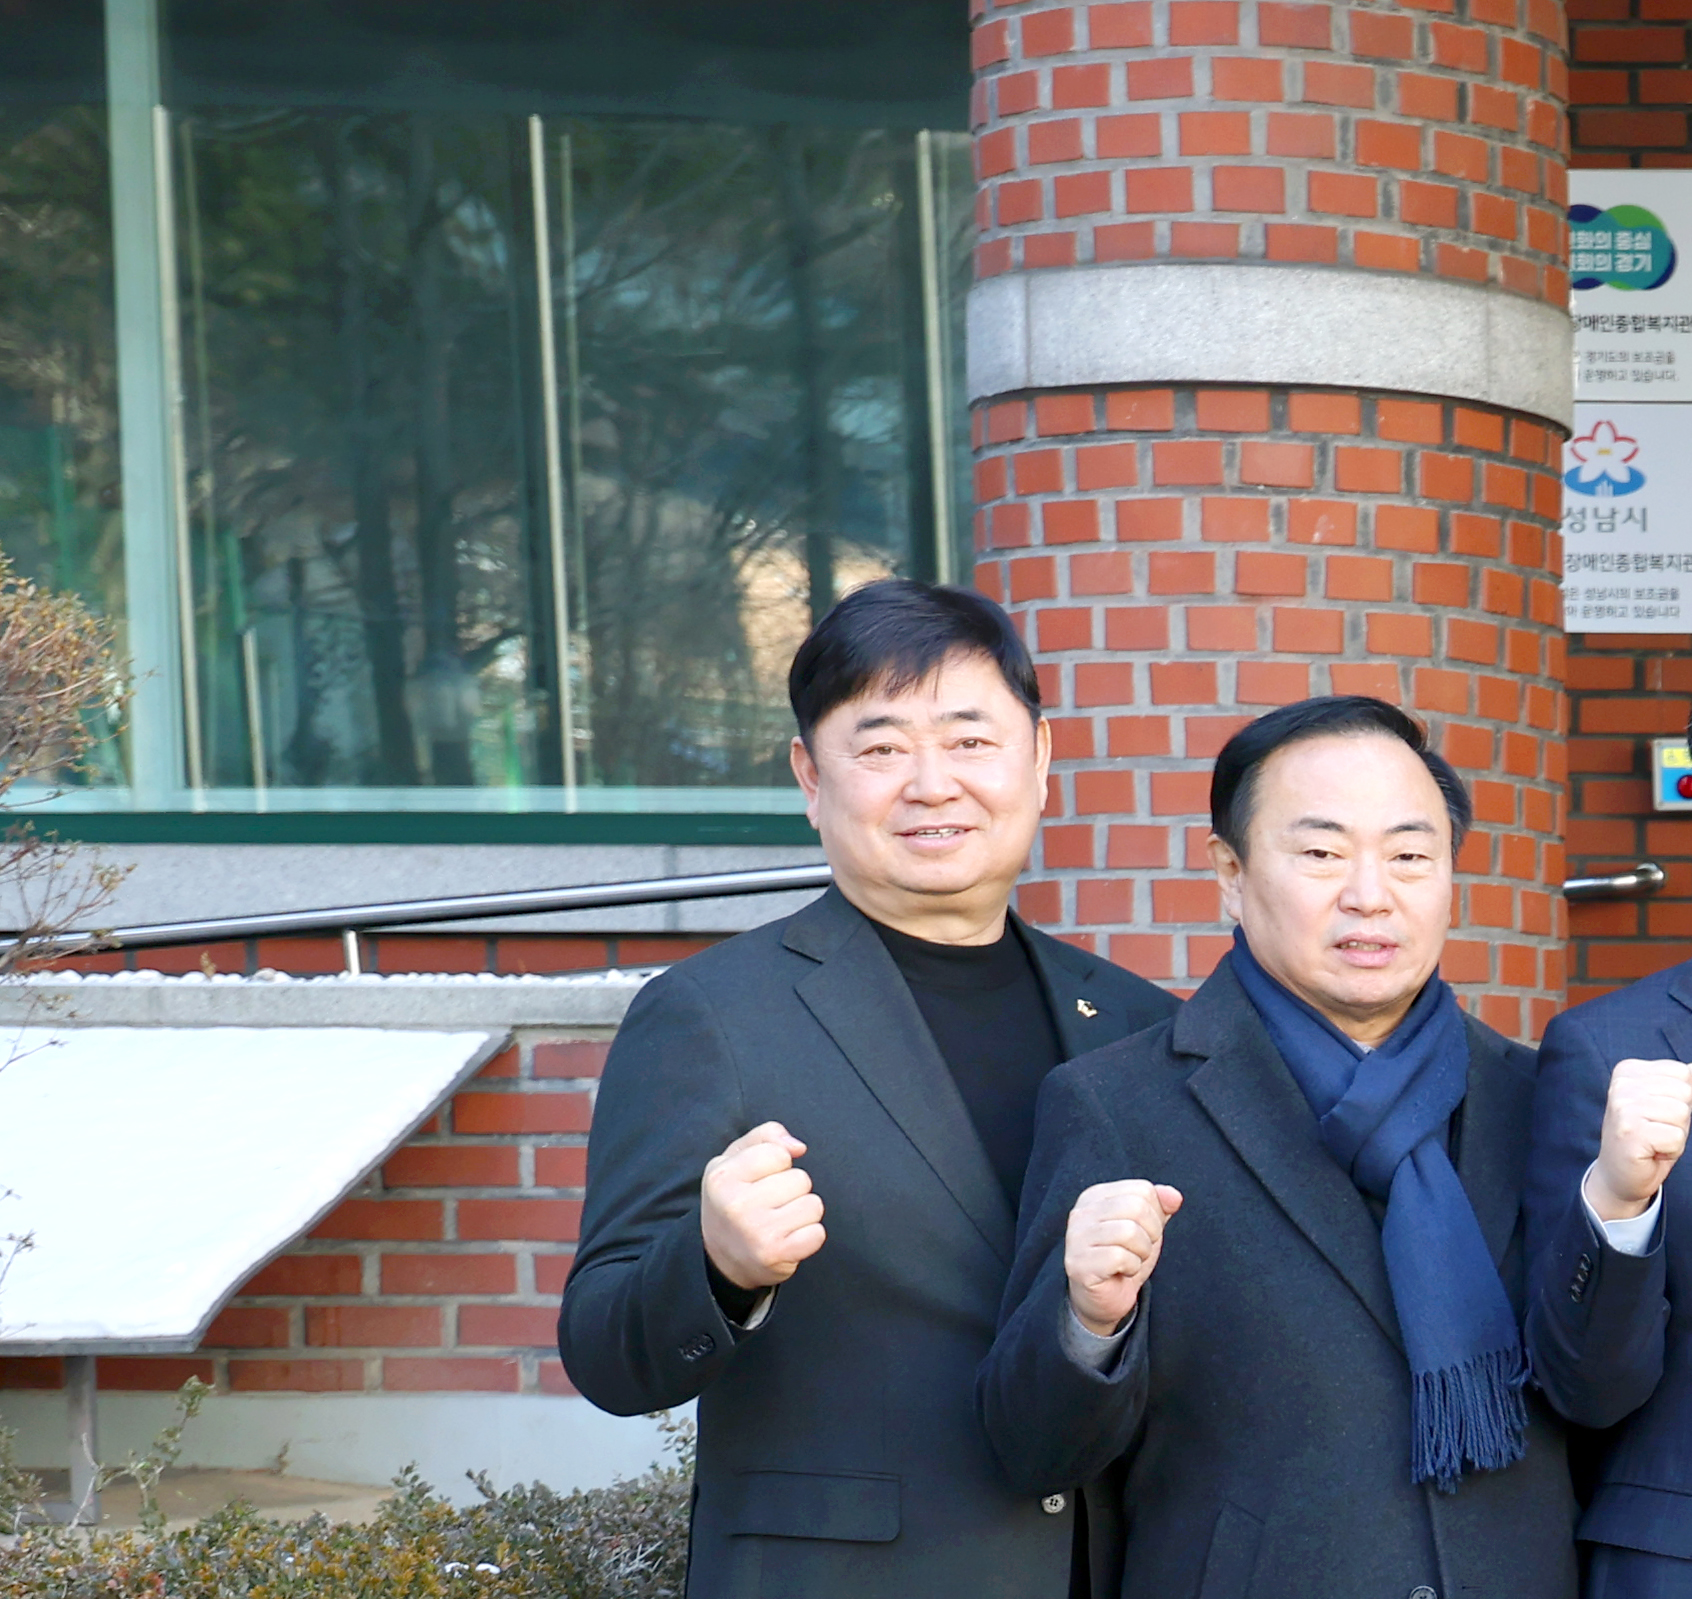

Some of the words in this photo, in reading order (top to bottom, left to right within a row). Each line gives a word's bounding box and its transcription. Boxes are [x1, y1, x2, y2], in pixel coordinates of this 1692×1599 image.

[1570, 231, 1612, 249] 화의
[1570, 253, 1612, 272] 회의
[1615, 253, 1652, 273] 경기
[1564, 506, 1648, 534] 성남시
